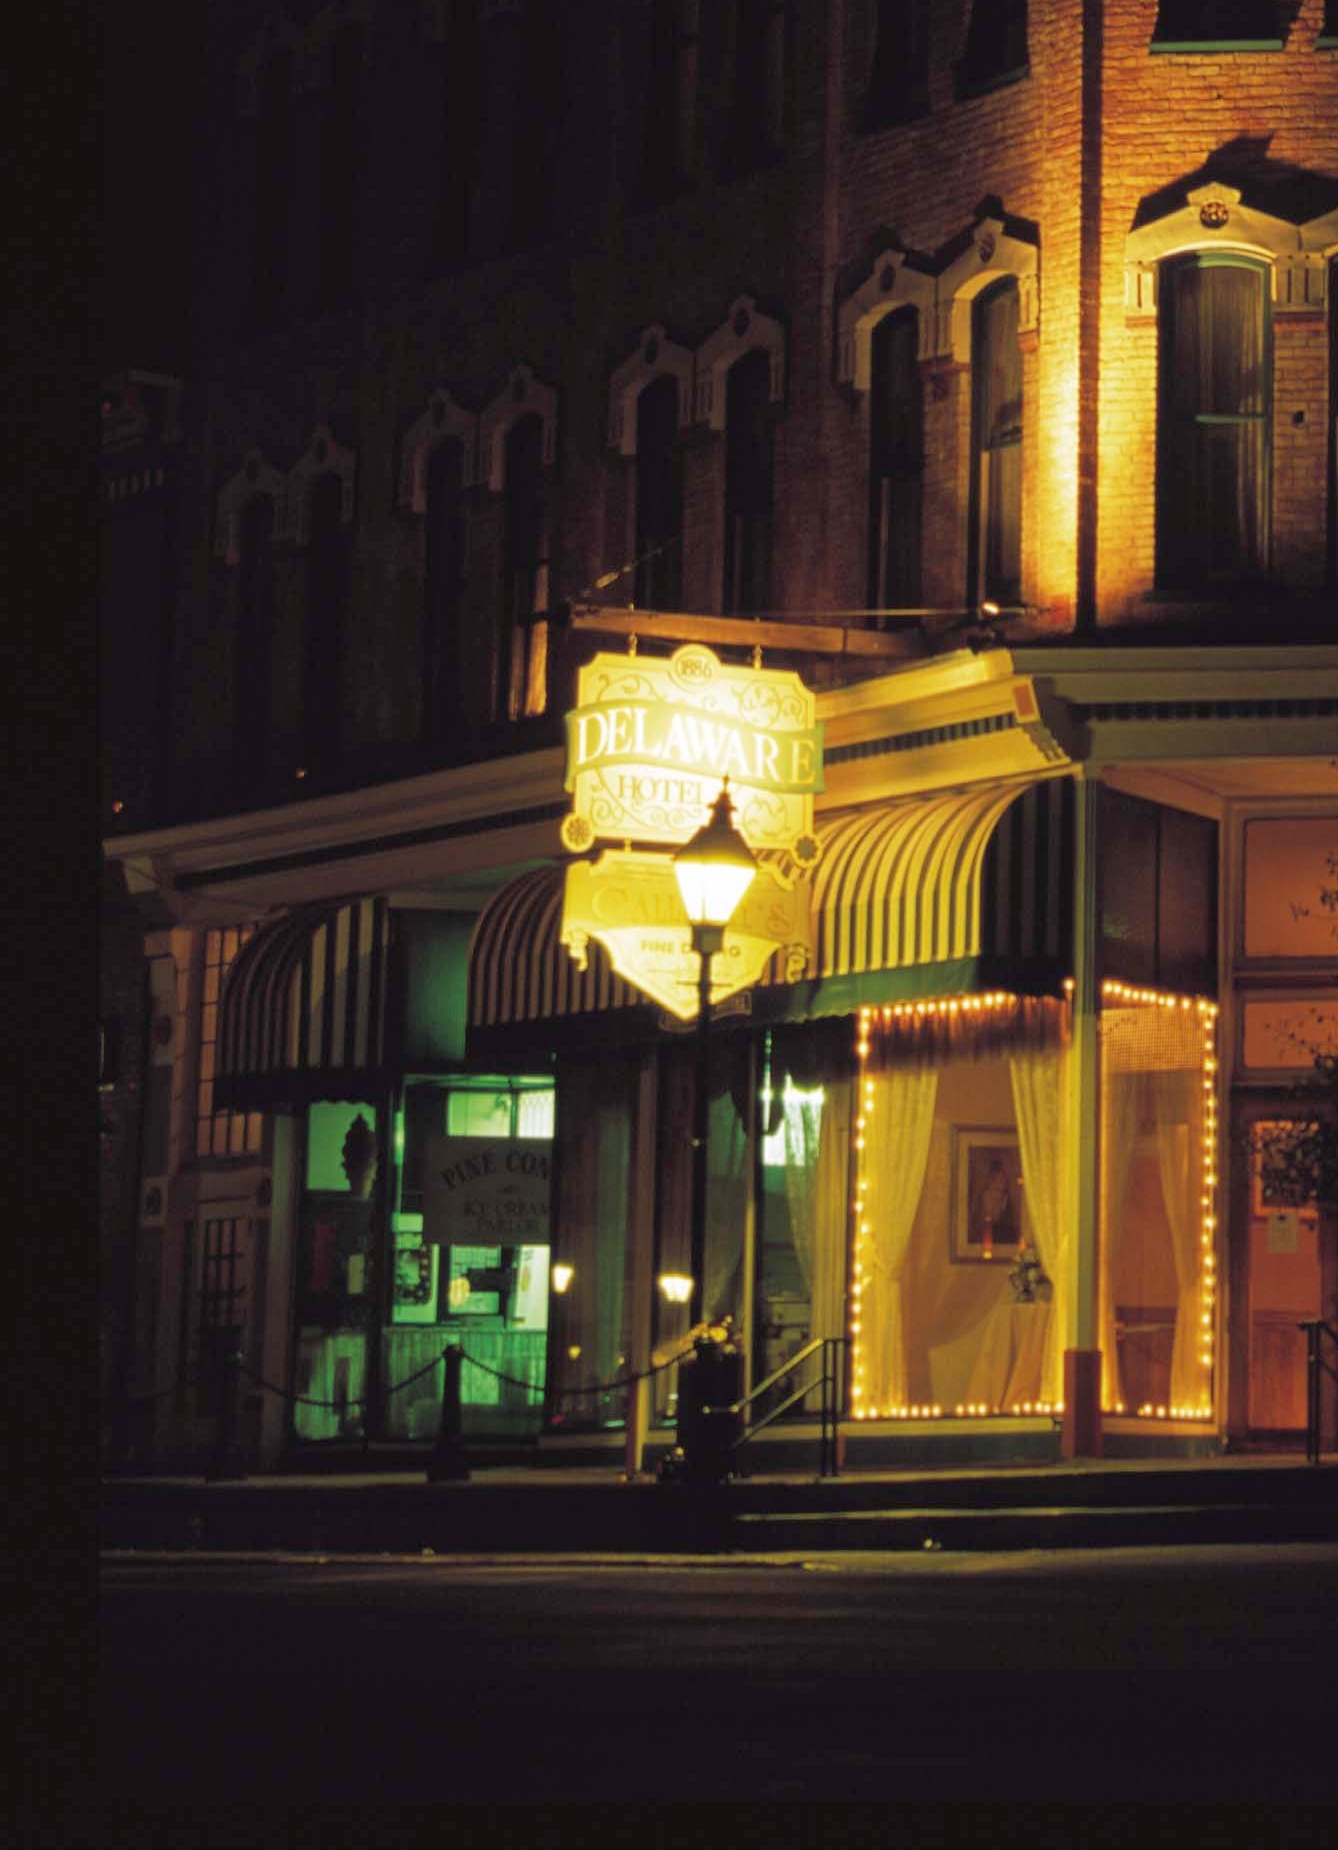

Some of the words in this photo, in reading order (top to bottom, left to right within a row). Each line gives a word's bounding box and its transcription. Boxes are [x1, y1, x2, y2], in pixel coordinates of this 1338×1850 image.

[576, 707, 817, 785] DELAWARE
[618, 775, 705, 805] HOTEL
[440, 1152, 497, 1191] PINE
